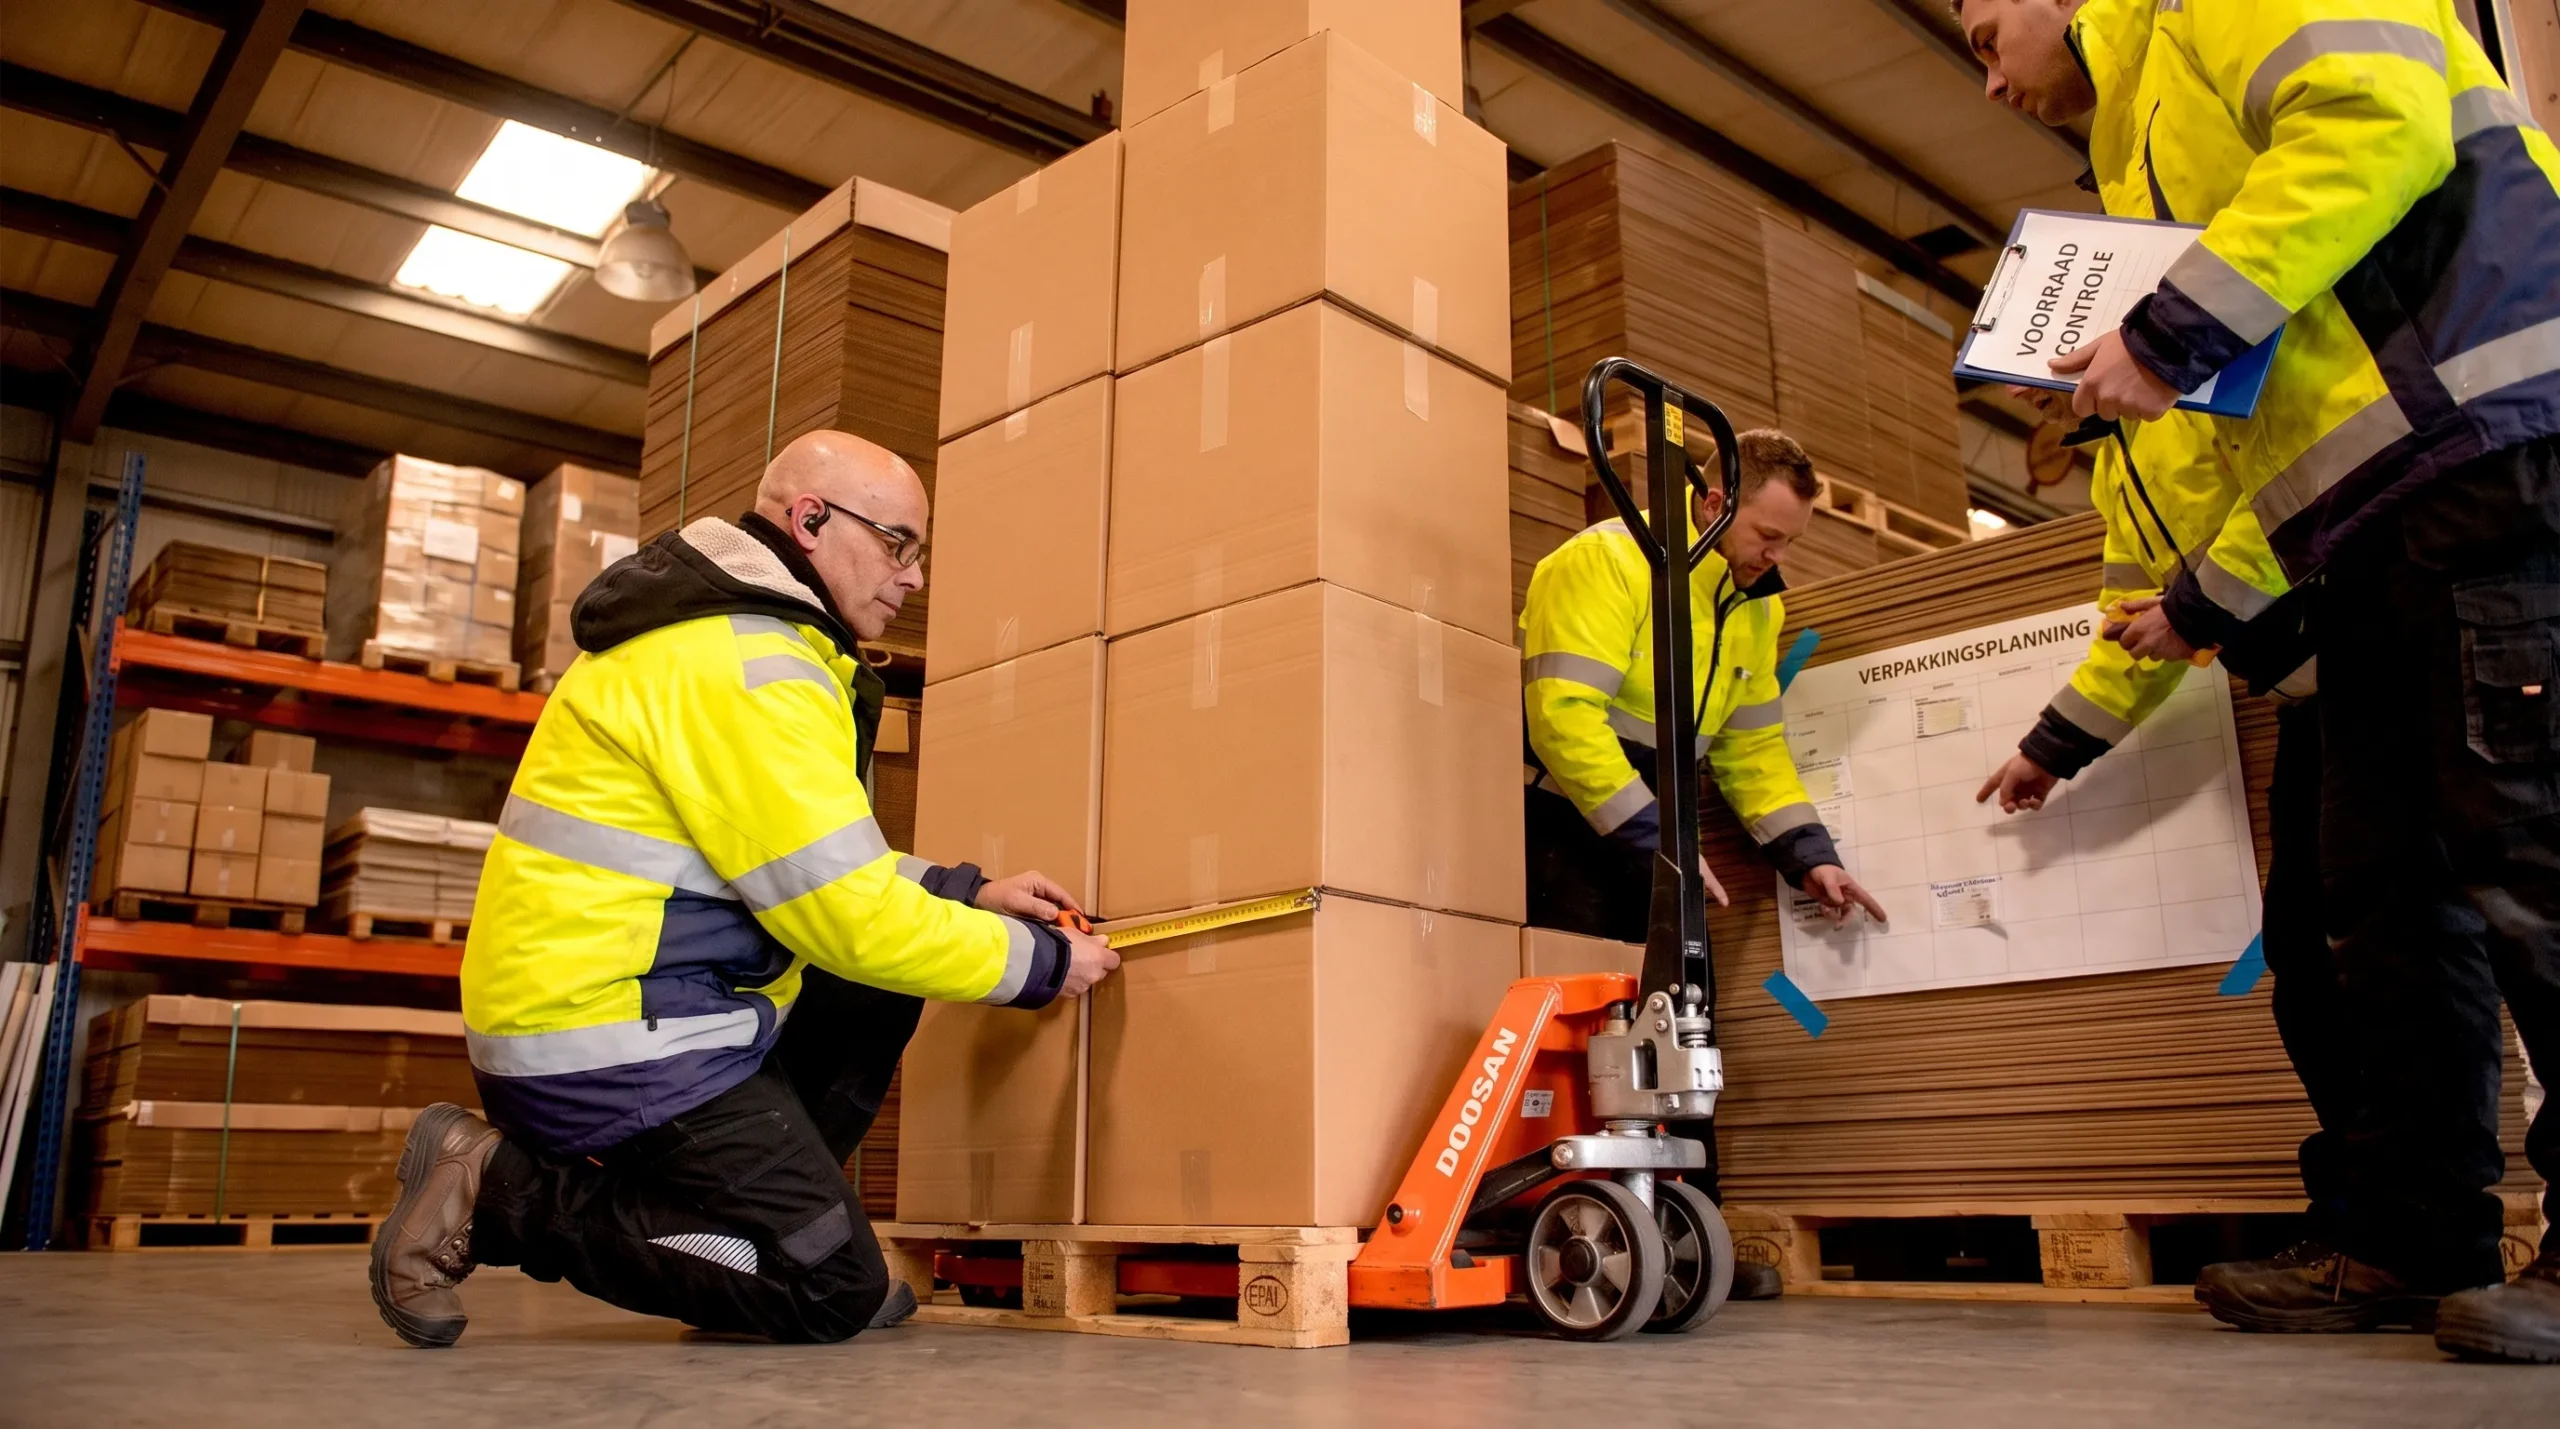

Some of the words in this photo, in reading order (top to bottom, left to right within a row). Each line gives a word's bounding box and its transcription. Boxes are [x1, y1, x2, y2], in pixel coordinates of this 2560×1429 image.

[2016, 243, 2079, 357] VOORRAAD
[2055, 251, 2114, 357] CONTROLE
[1858, 619, 2091, 685] VERPAKKINGSPLANNING
[1434, 1027, 1518, 1179] DOOSAN
